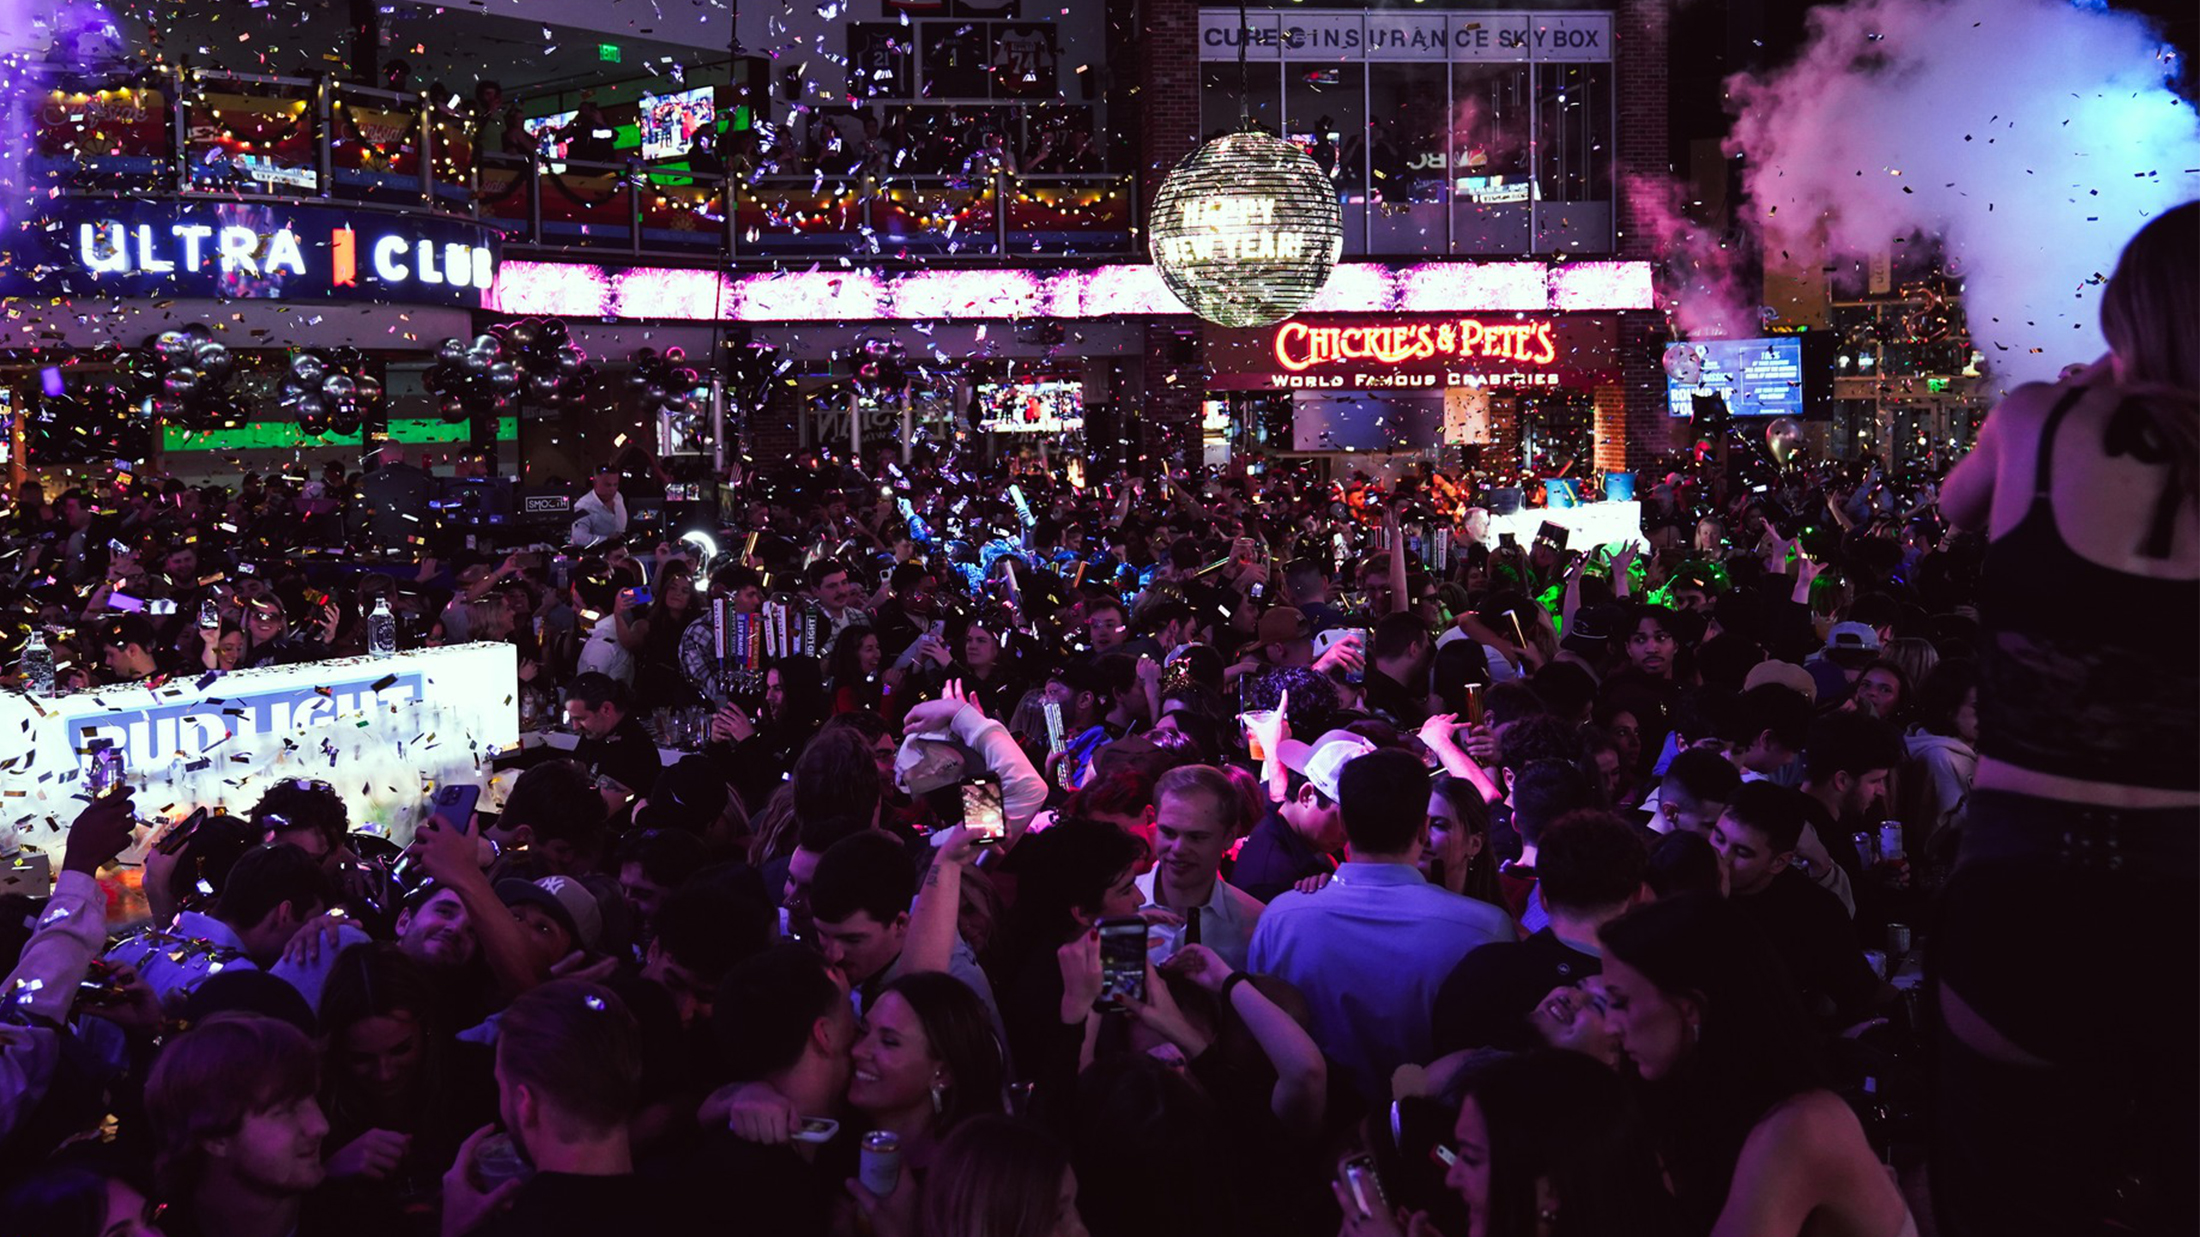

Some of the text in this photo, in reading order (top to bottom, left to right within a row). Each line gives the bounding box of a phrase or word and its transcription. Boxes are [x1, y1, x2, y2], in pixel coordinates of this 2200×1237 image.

[1204, 28, 1278, 46] CURE
[81, 223, 494, 289] ULTRA CLUB
[1273, 319, 1556, 371] CHICKIE'S & PETE'S
[1271, 373, 1560, 387] WORLD FAMOUS CRABFRIES
[807, 617, 816, 644] LIGHT
[80, 710, 227, 771] BUD
